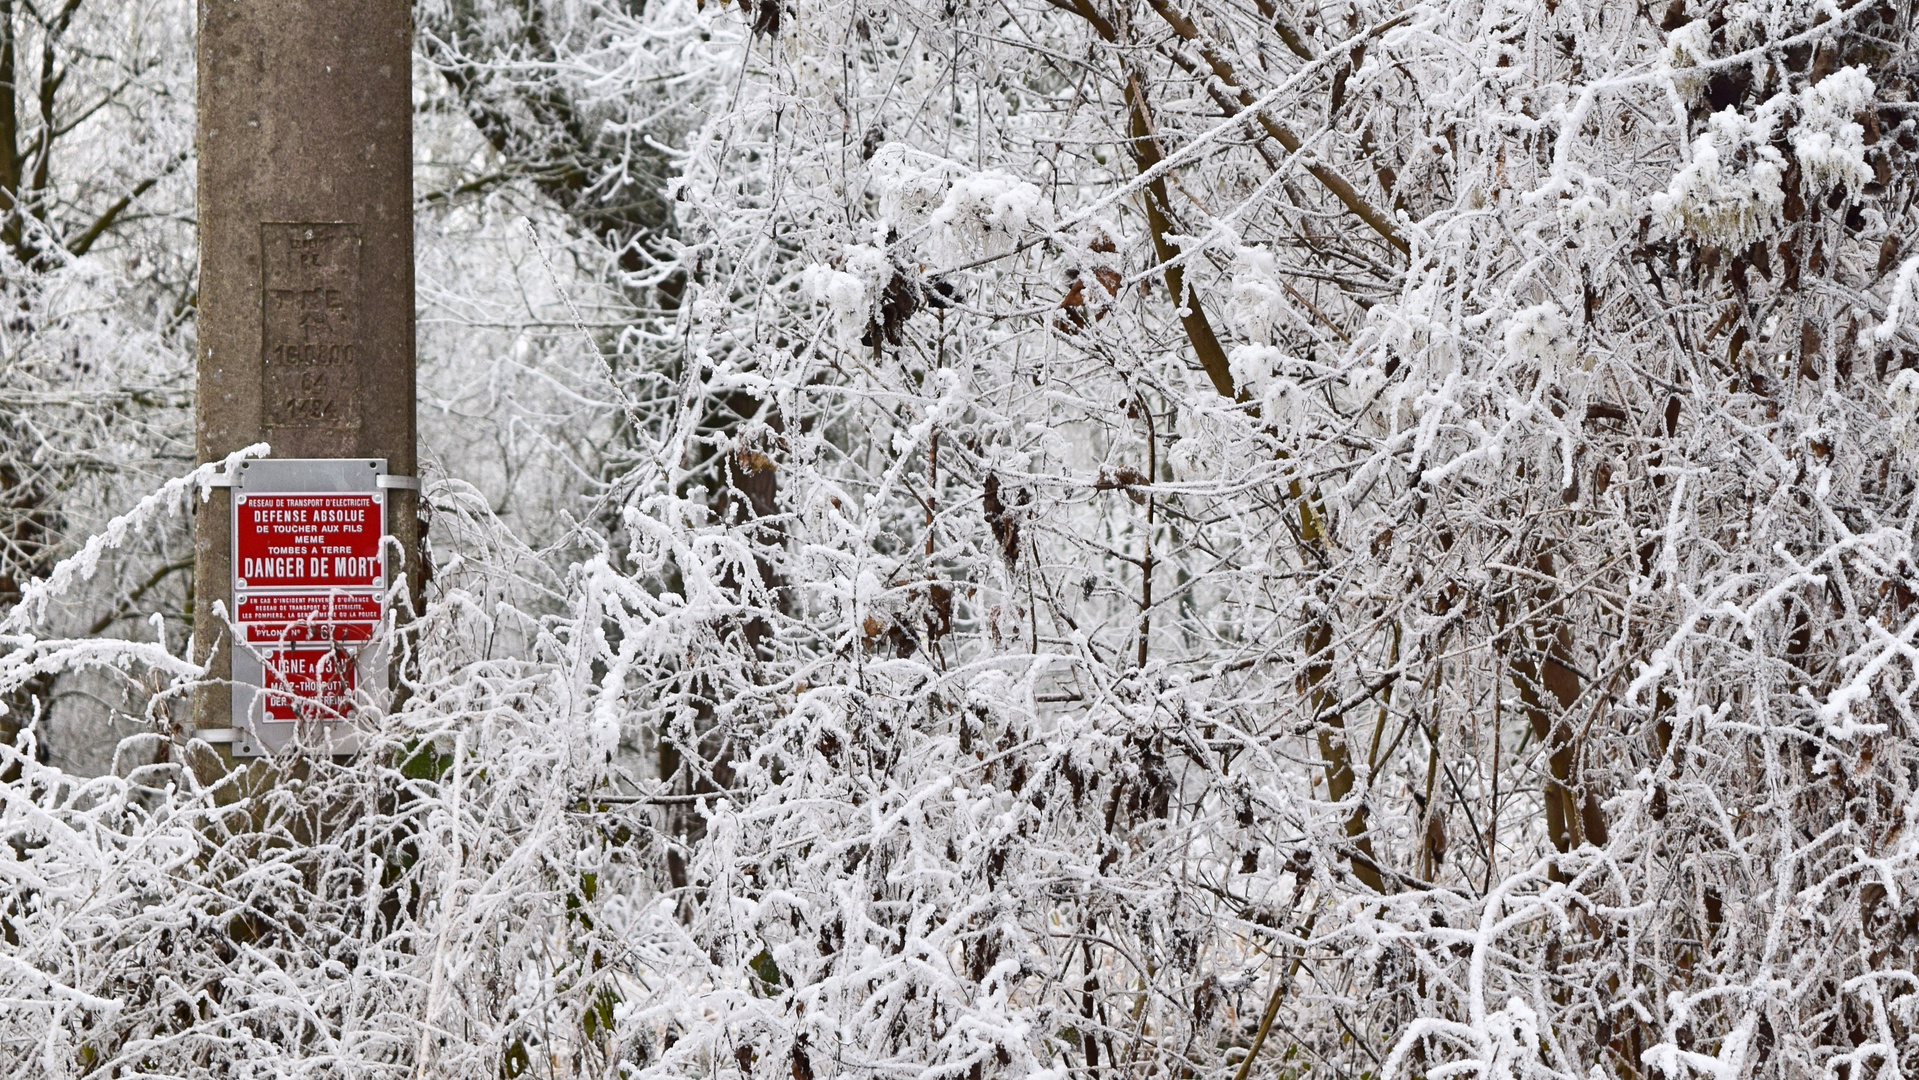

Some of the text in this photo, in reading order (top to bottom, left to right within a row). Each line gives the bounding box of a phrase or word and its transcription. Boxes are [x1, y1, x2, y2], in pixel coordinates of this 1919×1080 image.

[249, 499, 273, 507] RESEAU
[276, 499, 284, 507] DE
[287, 499, 323, 507] TRANSPORT
[254, 510, 365, 522] DEFENSE ABSOLUE
[245, 557, 376, 577] DANGER DE MORT
